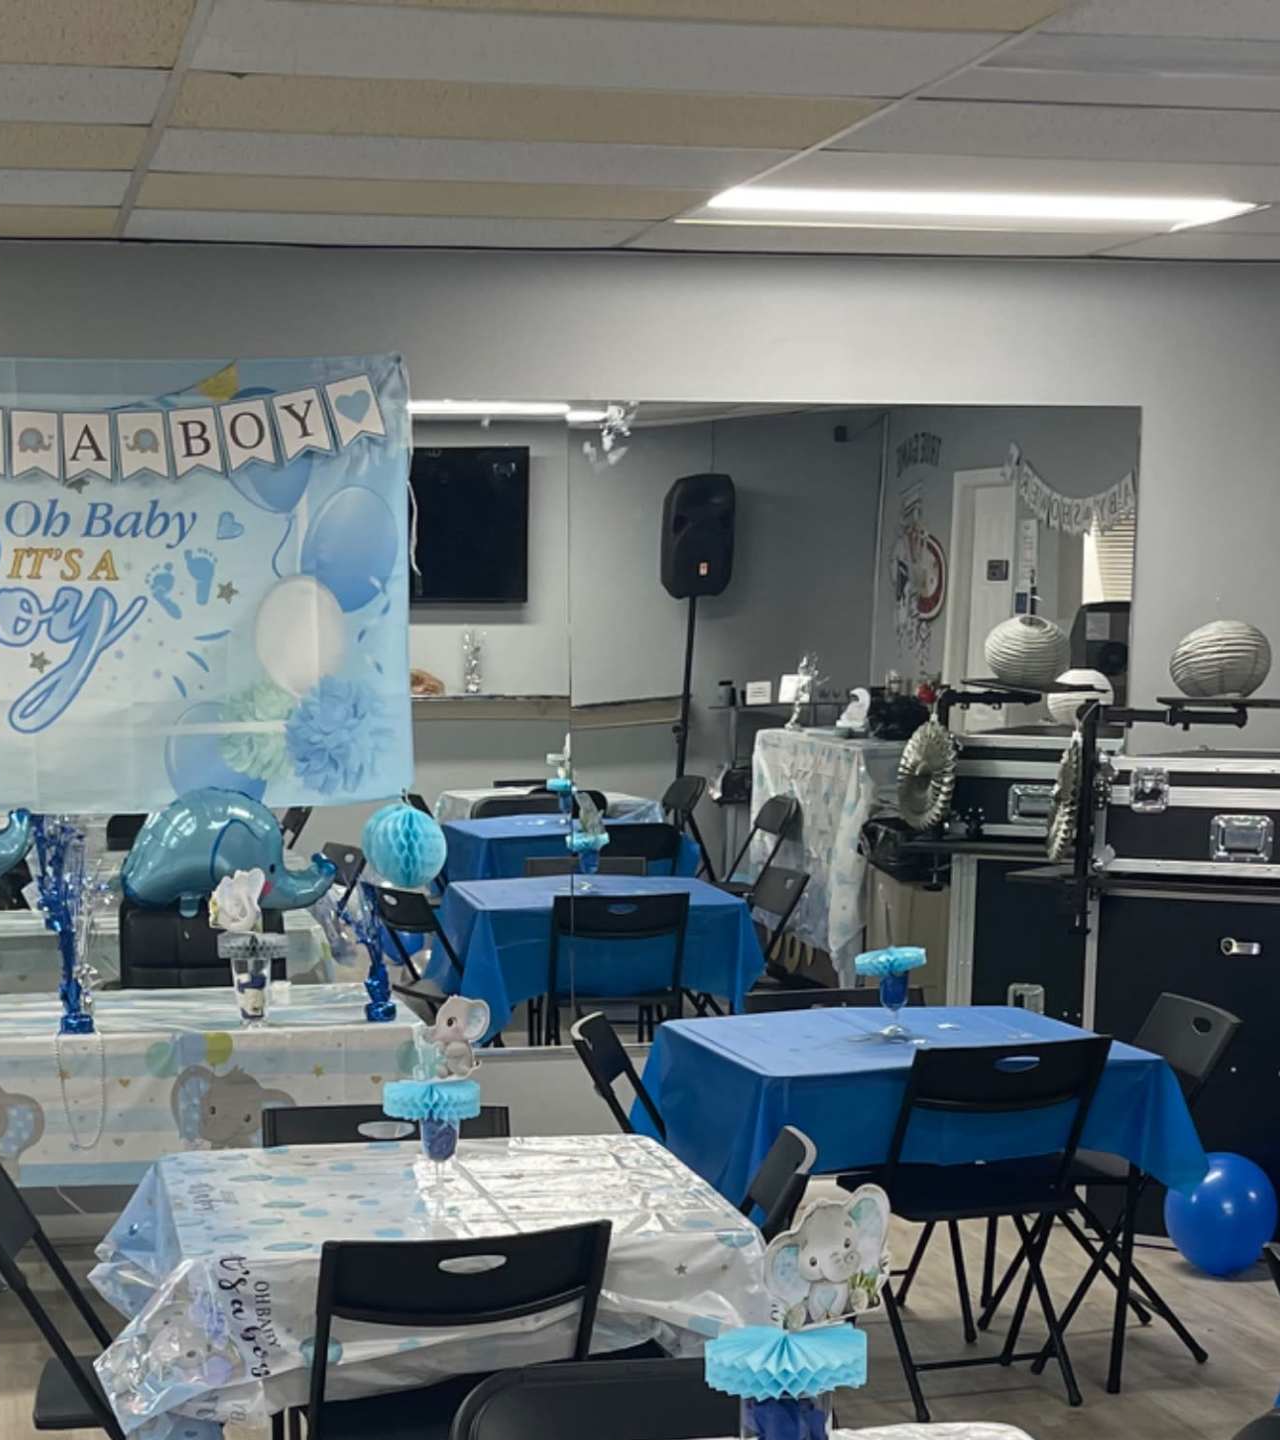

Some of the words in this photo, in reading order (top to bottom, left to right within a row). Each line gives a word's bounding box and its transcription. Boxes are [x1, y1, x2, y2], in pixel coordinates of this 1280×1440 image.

[70, 424, 109, 463] A
[180, 400, 314, 458] BOY
[5, 499, 71, 538] Oh
[80, 499, 198, 549] Baby
[6, 547, 85, 581] IT'S
[87, 549, 120, 582] A
[254, 1280, 271, 1304] OH
